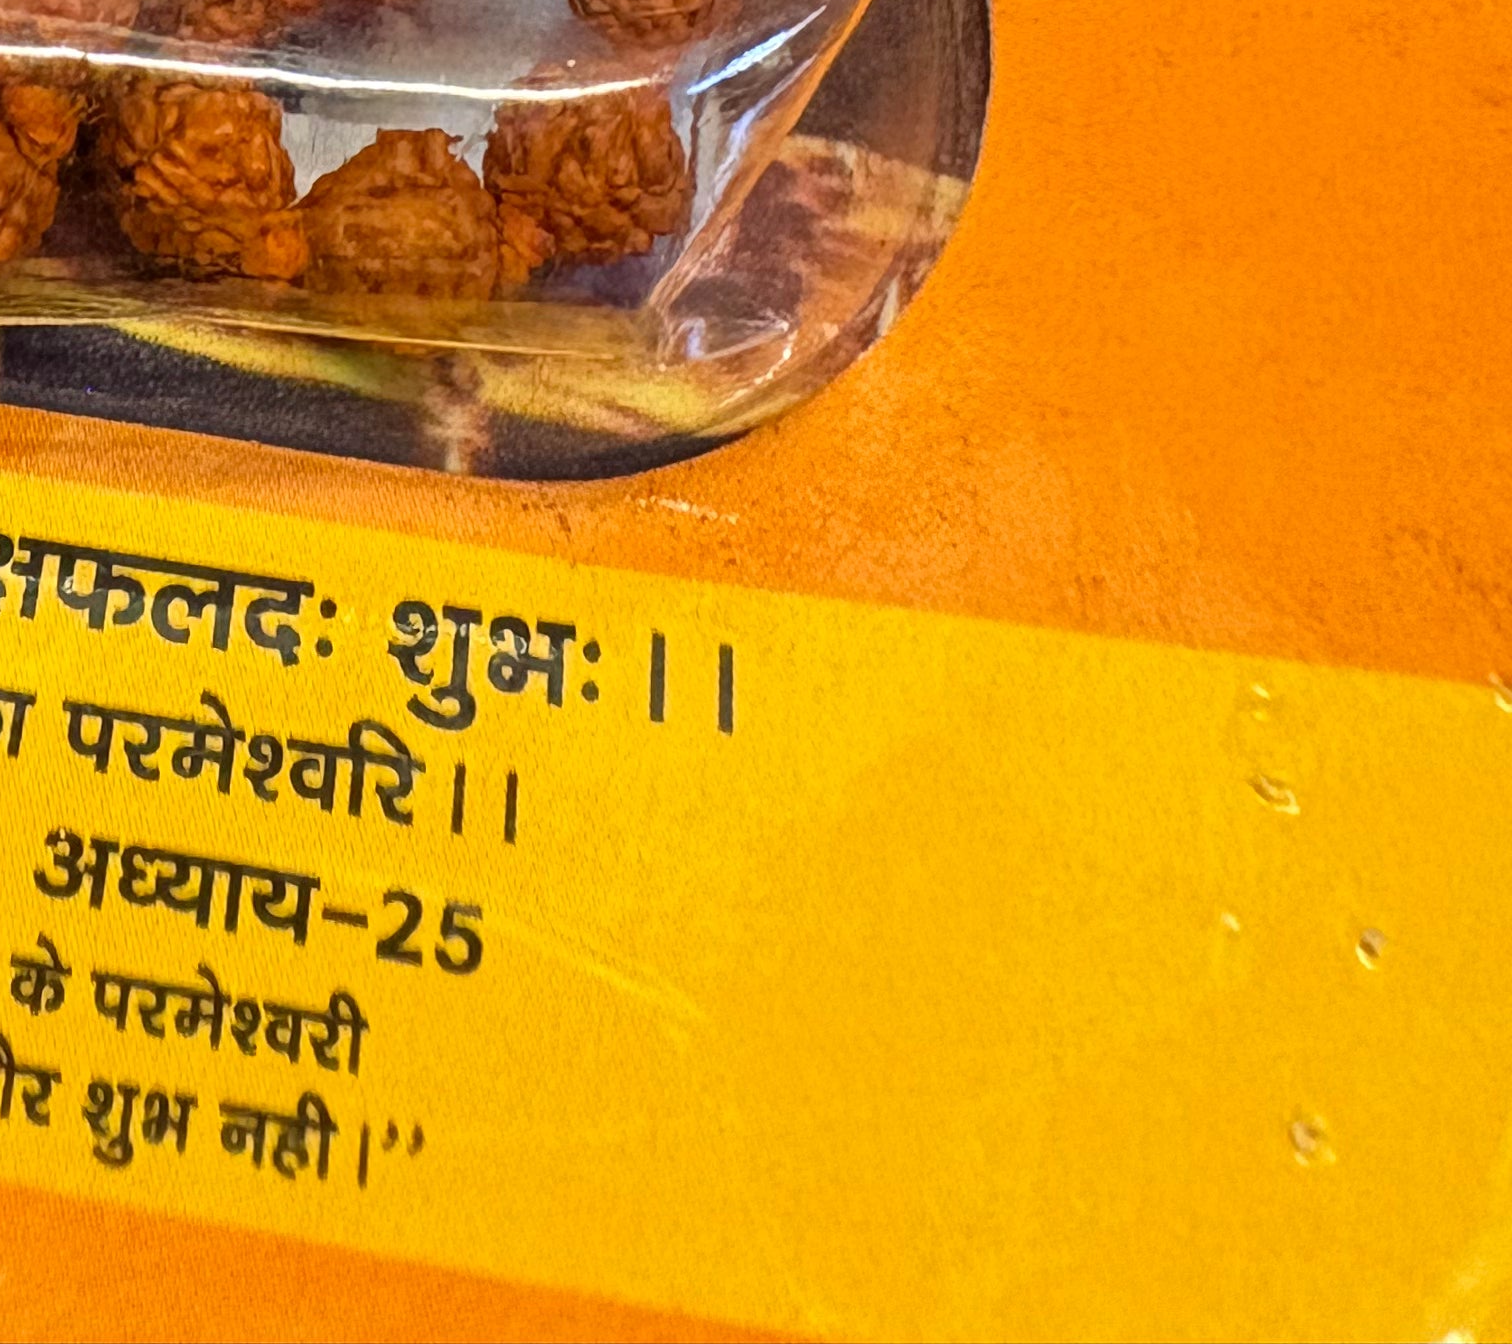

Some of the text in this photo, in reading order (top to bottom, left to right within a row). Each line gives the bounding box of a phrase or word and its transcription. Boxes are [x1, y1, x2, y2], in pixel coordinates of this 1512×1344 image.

[8, 931, 75, 1018] के
[88, 962, 371, 1075] परमेश्वरी
[80, 1079, 200, 1169] शुभ
